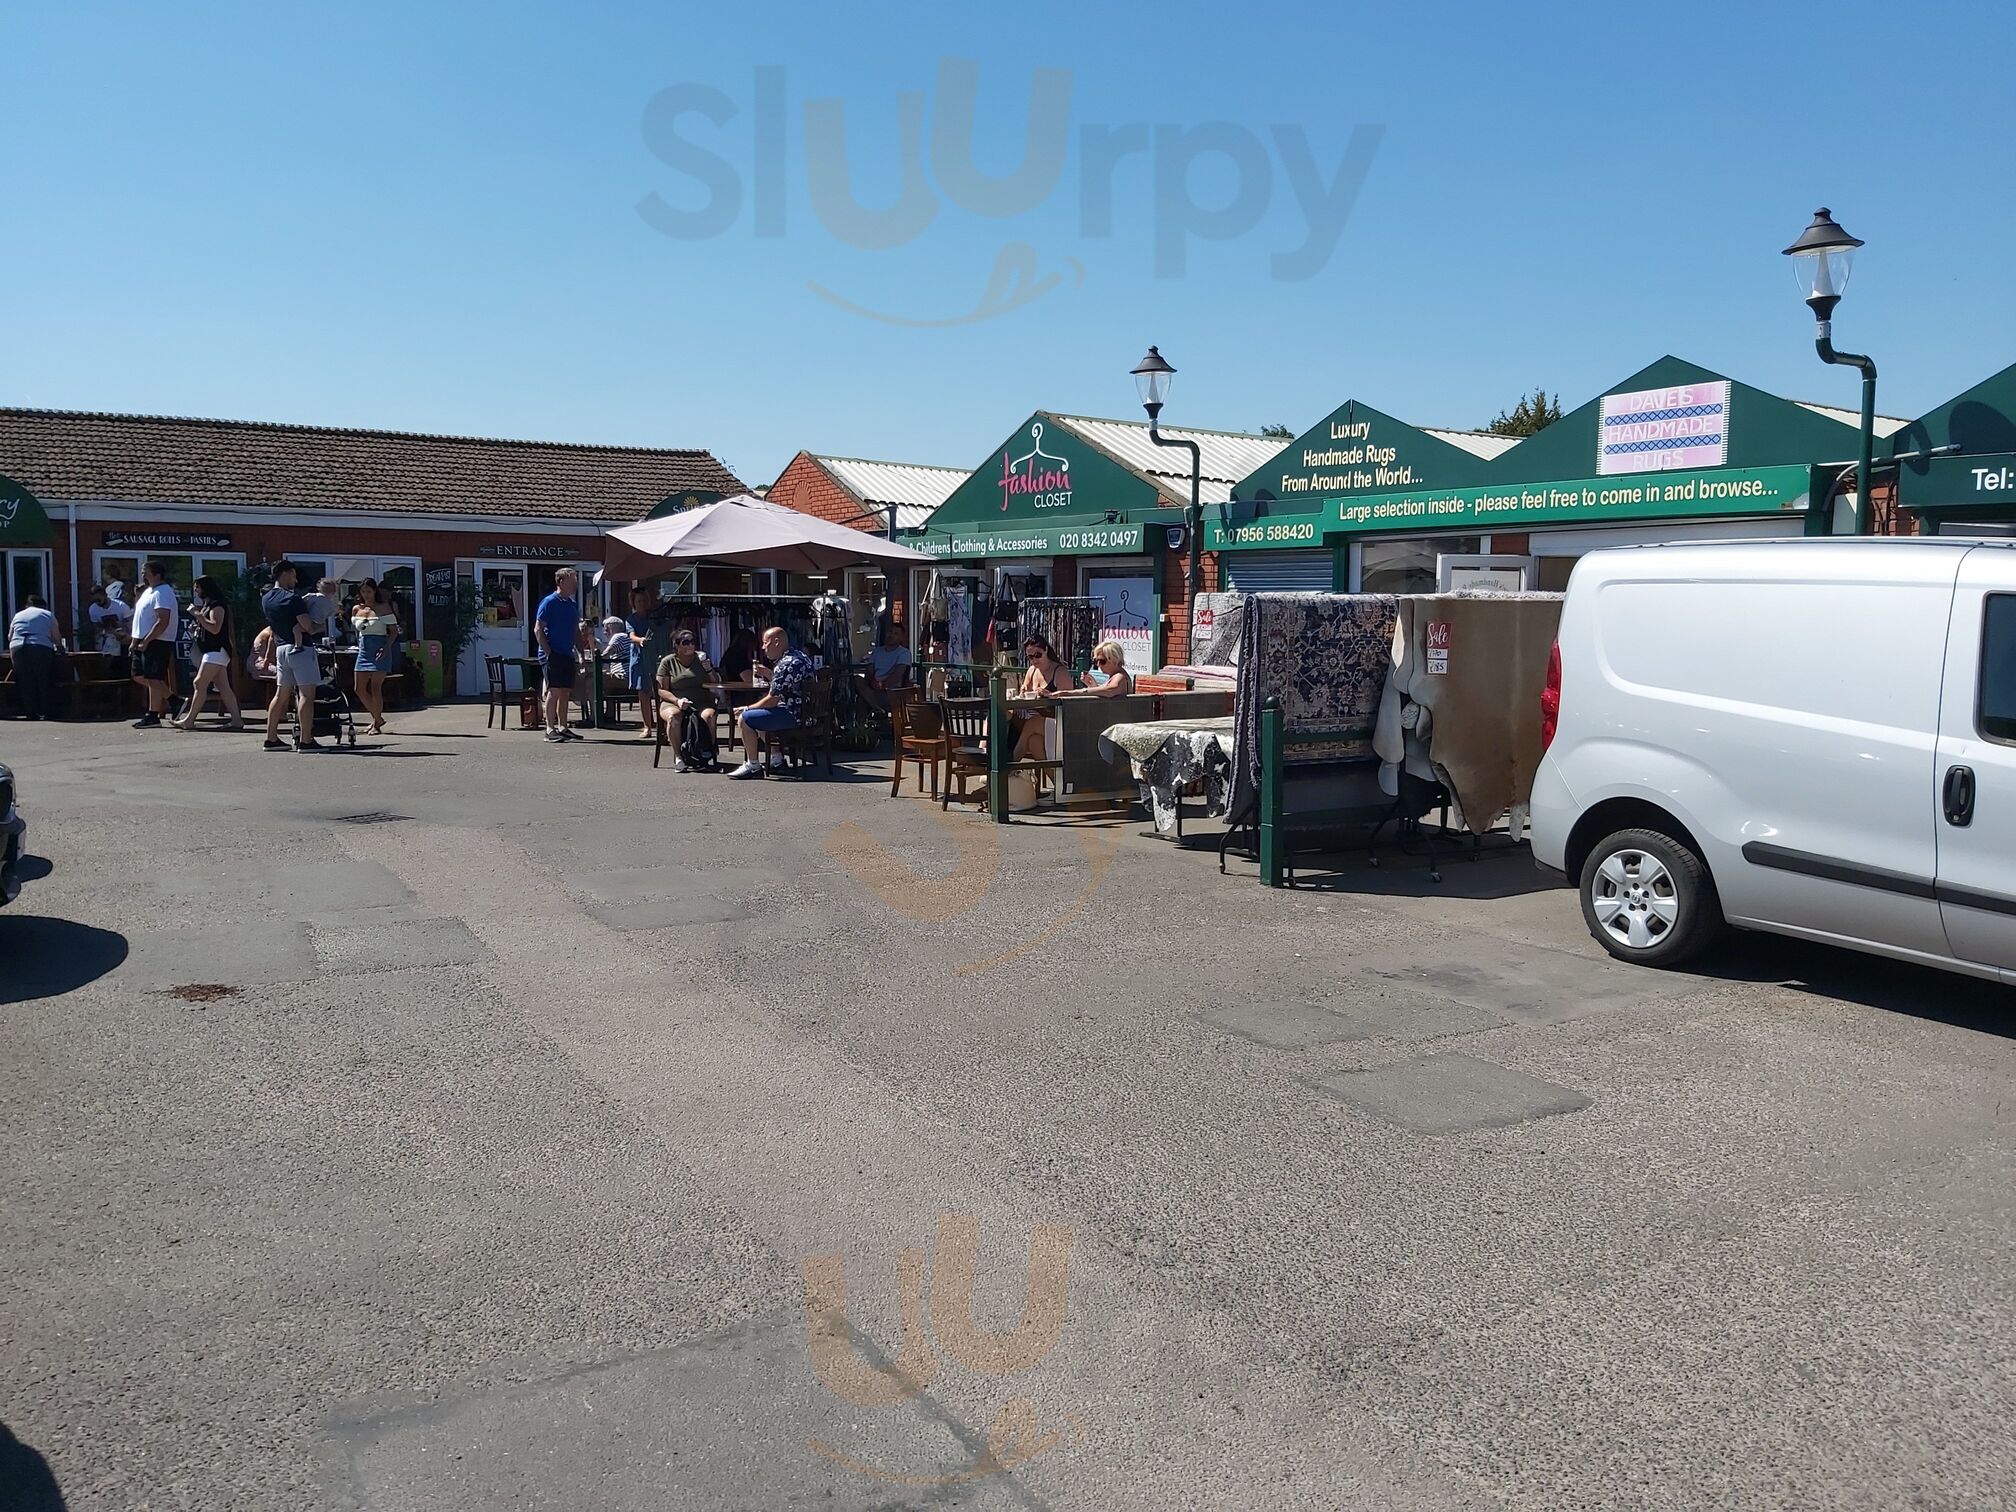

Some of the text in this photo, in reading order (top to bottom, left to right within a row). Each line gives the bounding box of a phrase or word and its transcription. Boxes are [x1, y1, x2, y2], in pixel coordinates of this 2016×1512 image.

[1331, 421, 1370, 441] Luxury
[1607, 416, 1713, 441] HANDMADE
[1303, 444, 1396, 467] Handmade Rugs
[1632, 450, 1685, 471] RUGS
[998, 451, 1071, 511] fashion
[1281, 466, 1423, 493] From Around the World...
[1971, 467, 2014, 490] Tel:
[1034, 491, 1072, 508] CLOSET
[1339, 502, 1371, 523] Large
[1373, 499, 1425, 518] selection
[1428, 497, 1465, 514] inside
[1474, 493, 1518, 516] please
[1520, 490, 1546, 509] feel
[1549, 489, 1578, 507] free
[1582, 487, 1596, 506] to
[1600, 487, 1642, 505] come
[1646, 483, 1660, 502] in
[1664, 480, 1695, 501] and
[1699, 479, 1778, 499] browse...
[952, 539, 986, 555] Clothing
[988, 538, 995, 551] &
[997, 536, 1047, 551] Accessories
[1060, 533, 1078, 548] 020
[1081, 532, 1107, 547] 8342
[1110, 530, 1138, 546] 0497
[1227, 526, 1264, 542] 07956
[1267, 523, 1314, 541] 588420
[496, 545, 564, 556] ENTRANCE
[1103, 614, 1151, 640] ashion
[1428, 623, 1448, 647] Sale
[1124, 662, 1148, 671] hildrens
